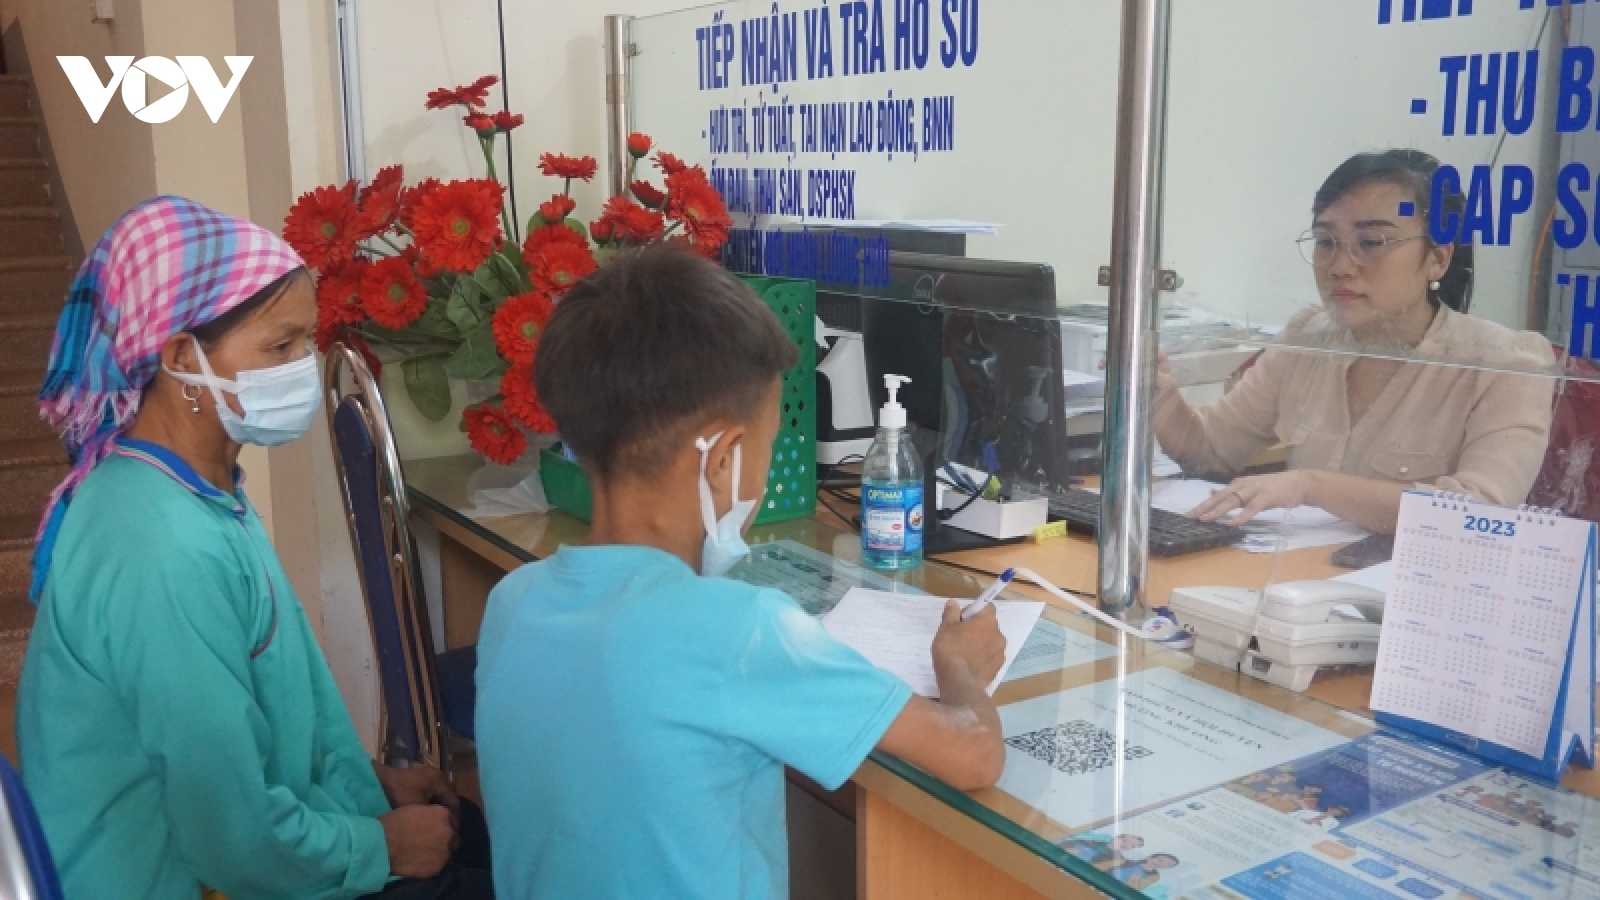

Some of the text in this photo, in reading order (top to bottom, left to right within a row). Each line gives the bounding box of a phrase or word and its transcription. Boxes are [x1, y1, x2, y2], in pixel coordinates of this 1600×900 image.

[696, 10, 734, 90] TIẾP
[740, 2, 797, 95] NHẬN
[800, 103, 818, 153] TAI
[821, 101, 847, 160] NẠN
[849, 100, 873, 153] LAO
[876, 89, 918, 162] ĐỘNG,
[922, 96, 954, 152] BNN
[1439, 50, 1540, 137] THU
[807, 169, 856, 220] DSPHSK
[1464, 513, 1516, 537] 2023
